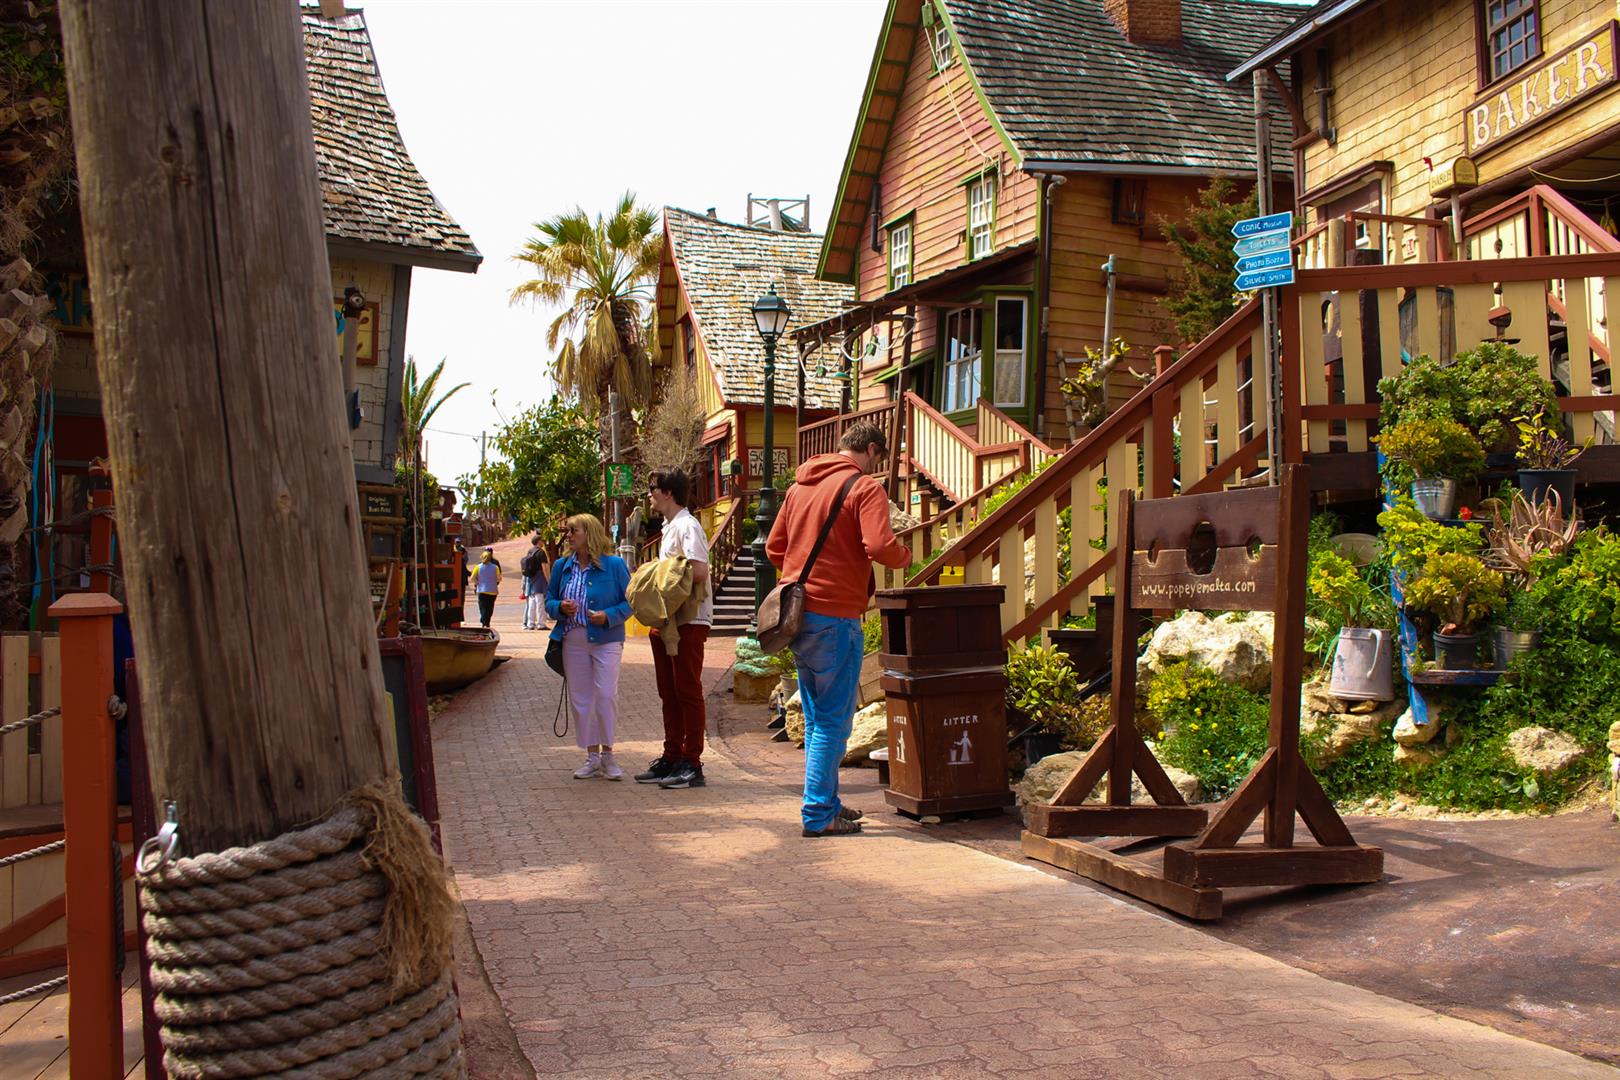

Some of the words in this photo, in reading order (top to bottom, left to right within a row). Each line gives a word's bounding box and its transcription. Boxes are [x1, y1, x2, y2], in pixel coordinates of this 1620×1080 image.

[1471, 41, 1607, 150] BAKER
[1241, 222, 1261, 232] COMIC
[750, 462, 787, 475] MAER
[1142, 578, 1255, 599] www.popeyemalta.com
[943, 714, 979, 726] LITTER
